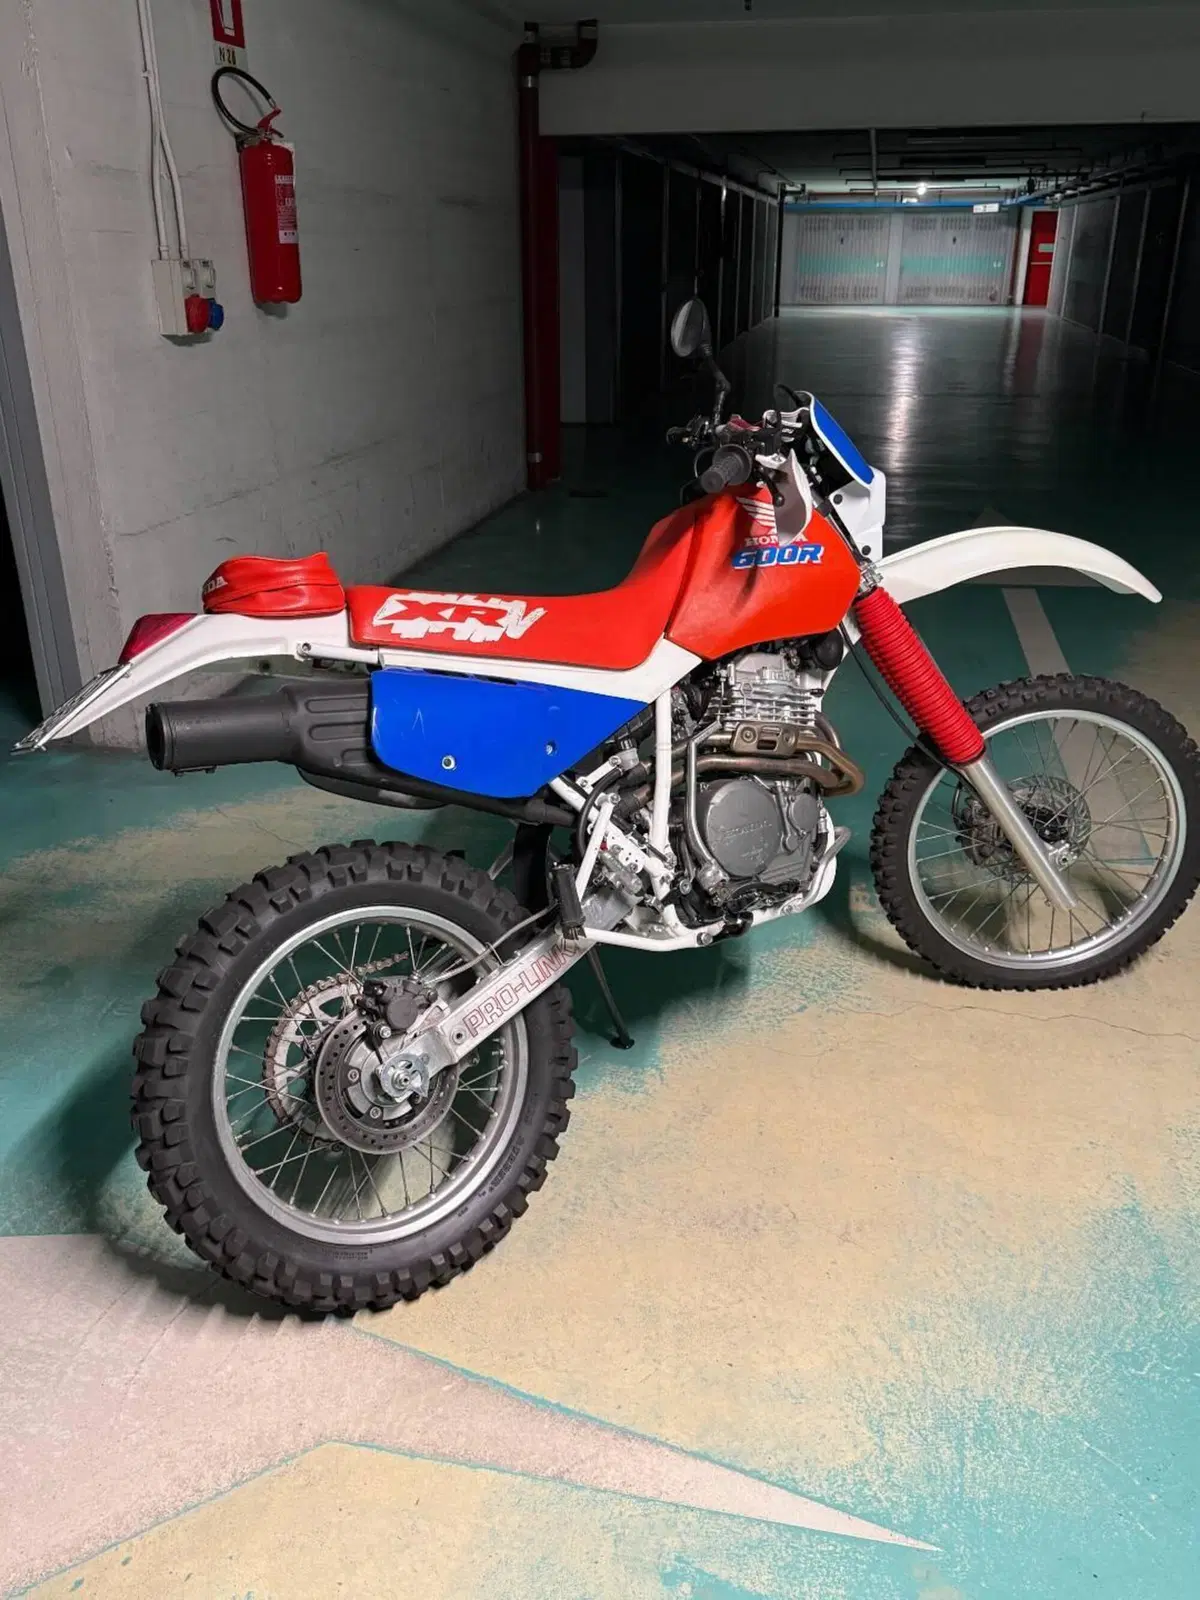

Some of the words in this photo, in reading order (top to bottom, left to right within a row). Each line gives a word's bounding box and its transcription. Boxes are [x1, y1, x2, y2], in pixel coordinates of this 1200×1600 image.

[744, 533, 808, 548] HONA
[731, 543, 825, 570] 600R
[377, 597, 508, 630] XR
[461, 938, 579, 1039] PRO-LINK
